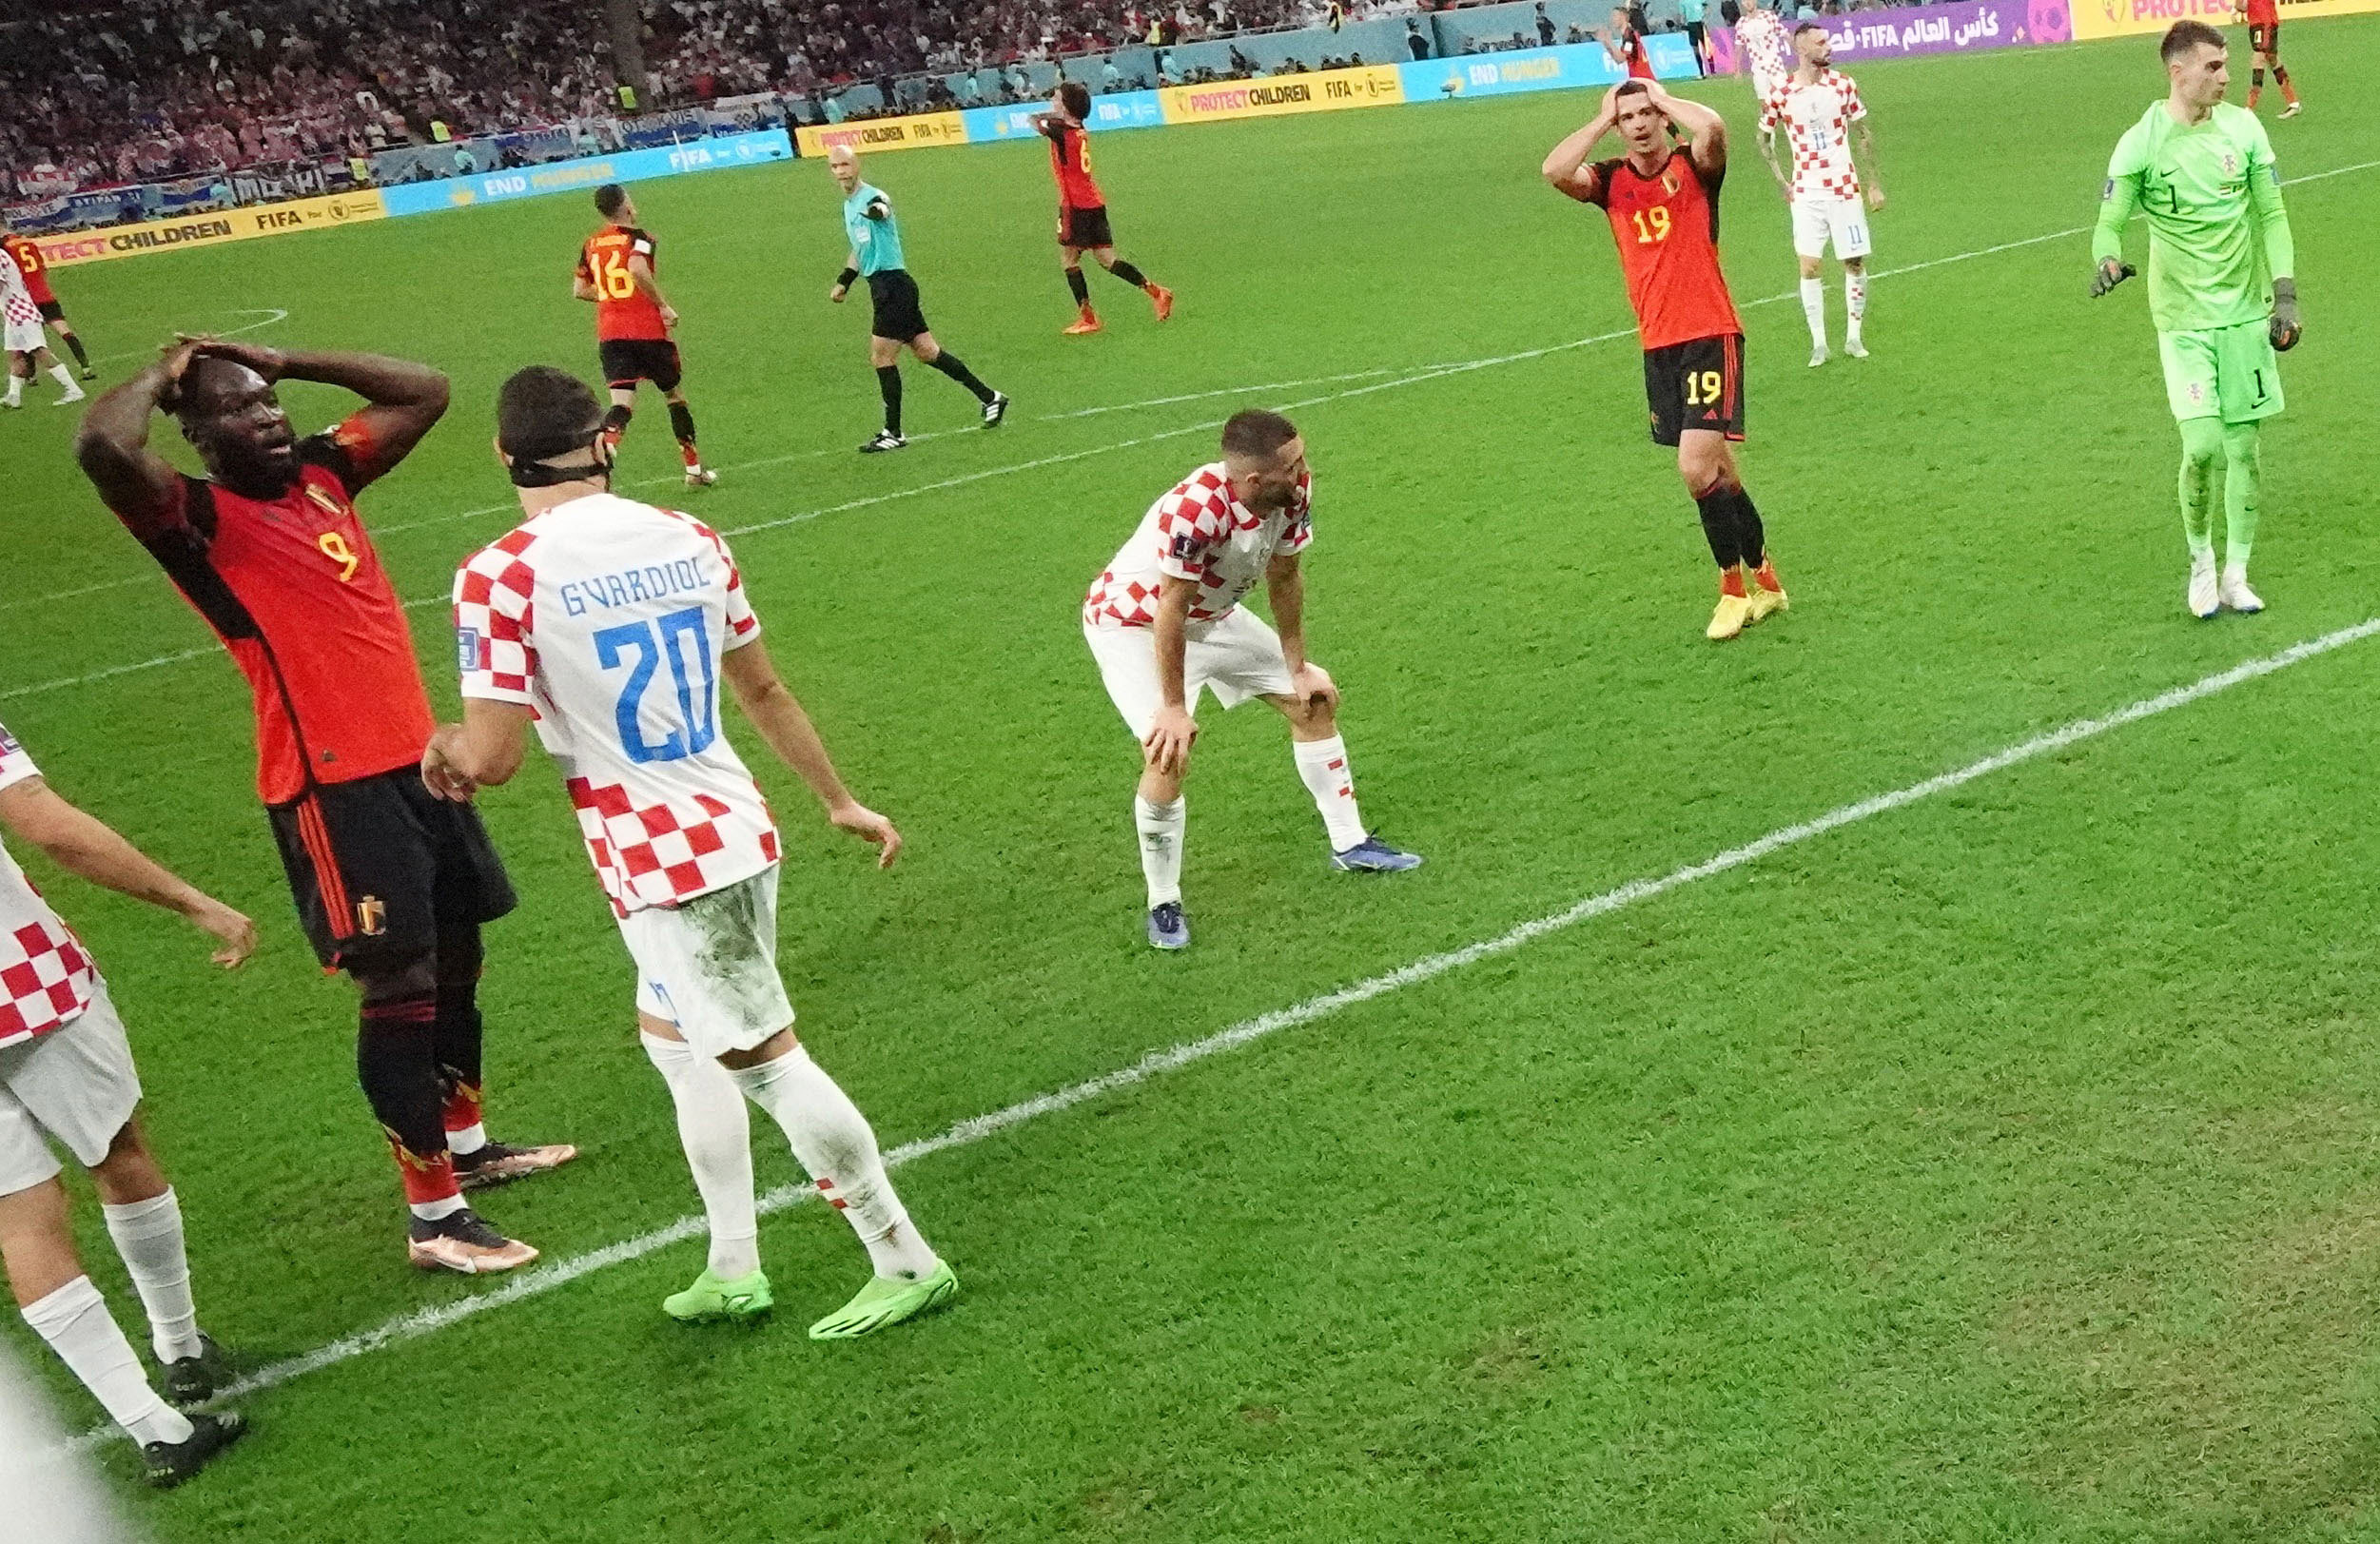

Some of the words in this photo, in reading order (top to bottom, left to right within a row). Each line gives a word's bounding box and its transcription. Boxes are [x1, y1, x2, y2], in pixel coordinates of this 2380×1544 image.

[1860, 24, 1900, 49] FIFA
[1902, 16, 1951, 50] العالم
[1954, 7, 2000, 46] كأس
[1190, 89, 1248, 112] PROTECT
[1249, 84, 1311, 107] CHILDREN
[1325, 80, 1353, 99] FIFA
[1812, 131, 1827, 150] 11
[483, 176, 527, 196] END
[2168, 185, 2179, 214] 1
[255, 210, 302, 229] FIFA
[1633, 205, 1671, 244] 19
[1848, 225, 1863, 244] 11
[109, 219, 232, 251] CHILDREN
[19, 245, 38, 273] 5
[590, 250, 635, 302] 16
[1687, 371, 1722, 405] 19
[2253, 369, 2267, 399] 1
[319, 532, 359, 582] 9
[560, 555, 712, 616] GVARDIOL
[592, 604, 716, 764] 20
